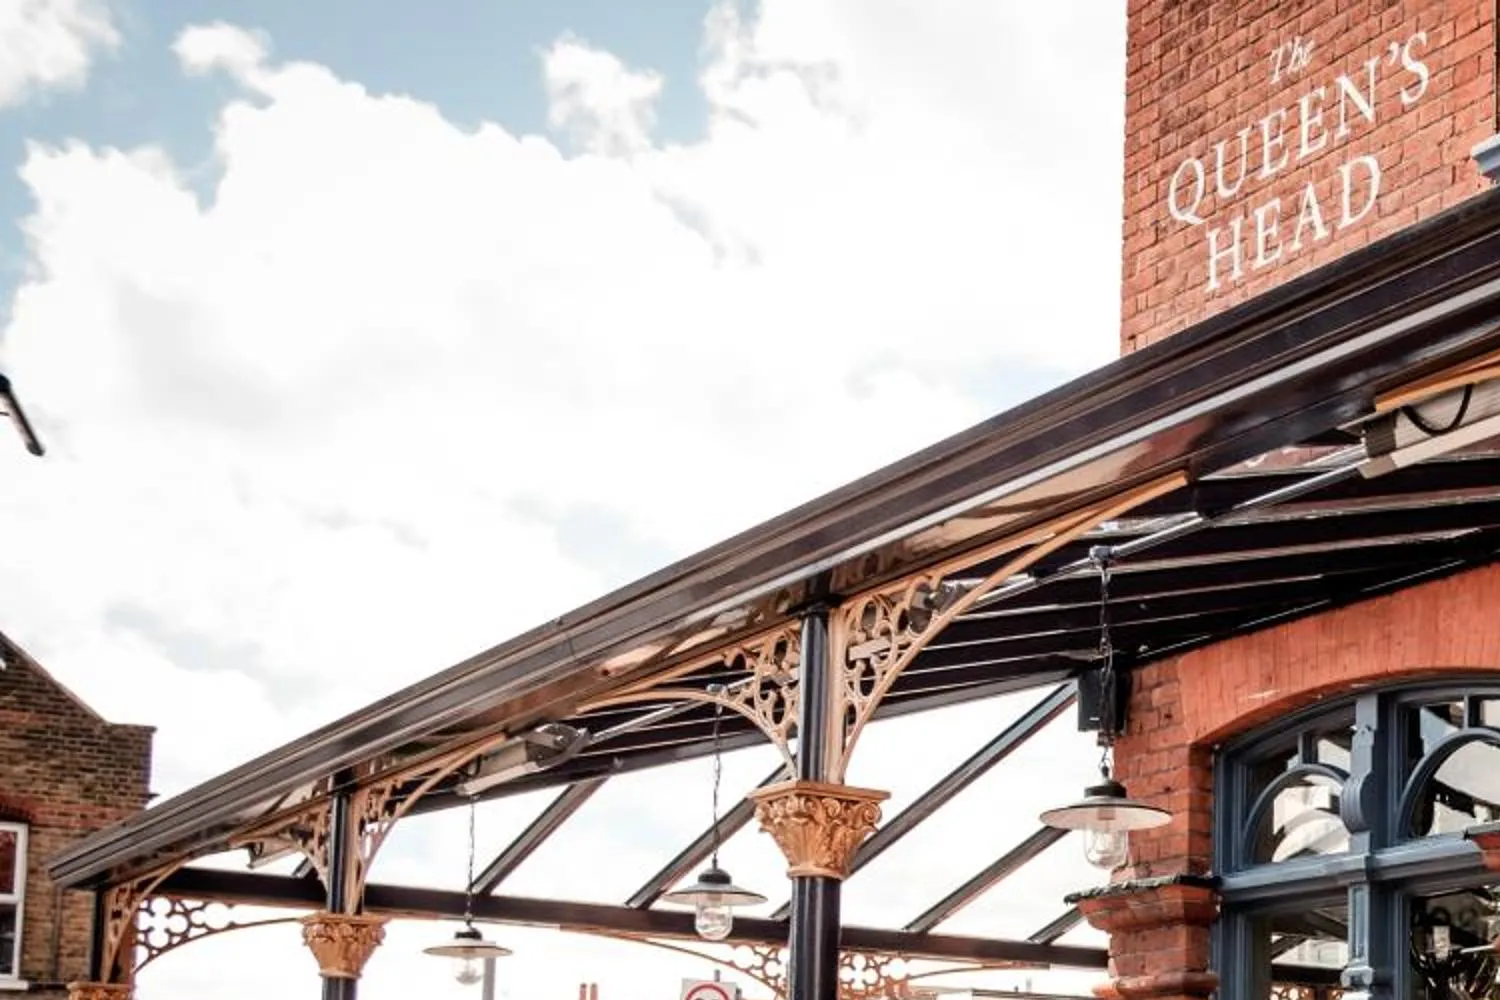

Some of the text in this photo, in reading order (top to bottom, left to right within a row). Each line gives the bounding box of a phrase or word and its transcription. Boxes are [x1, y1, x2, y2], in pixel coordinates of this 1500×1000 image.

[1167, 30, 1431, 226] QUEEN'S
[1269, 35, 1316, 85] The
[1204, 154, 1381, 293] HEAD
